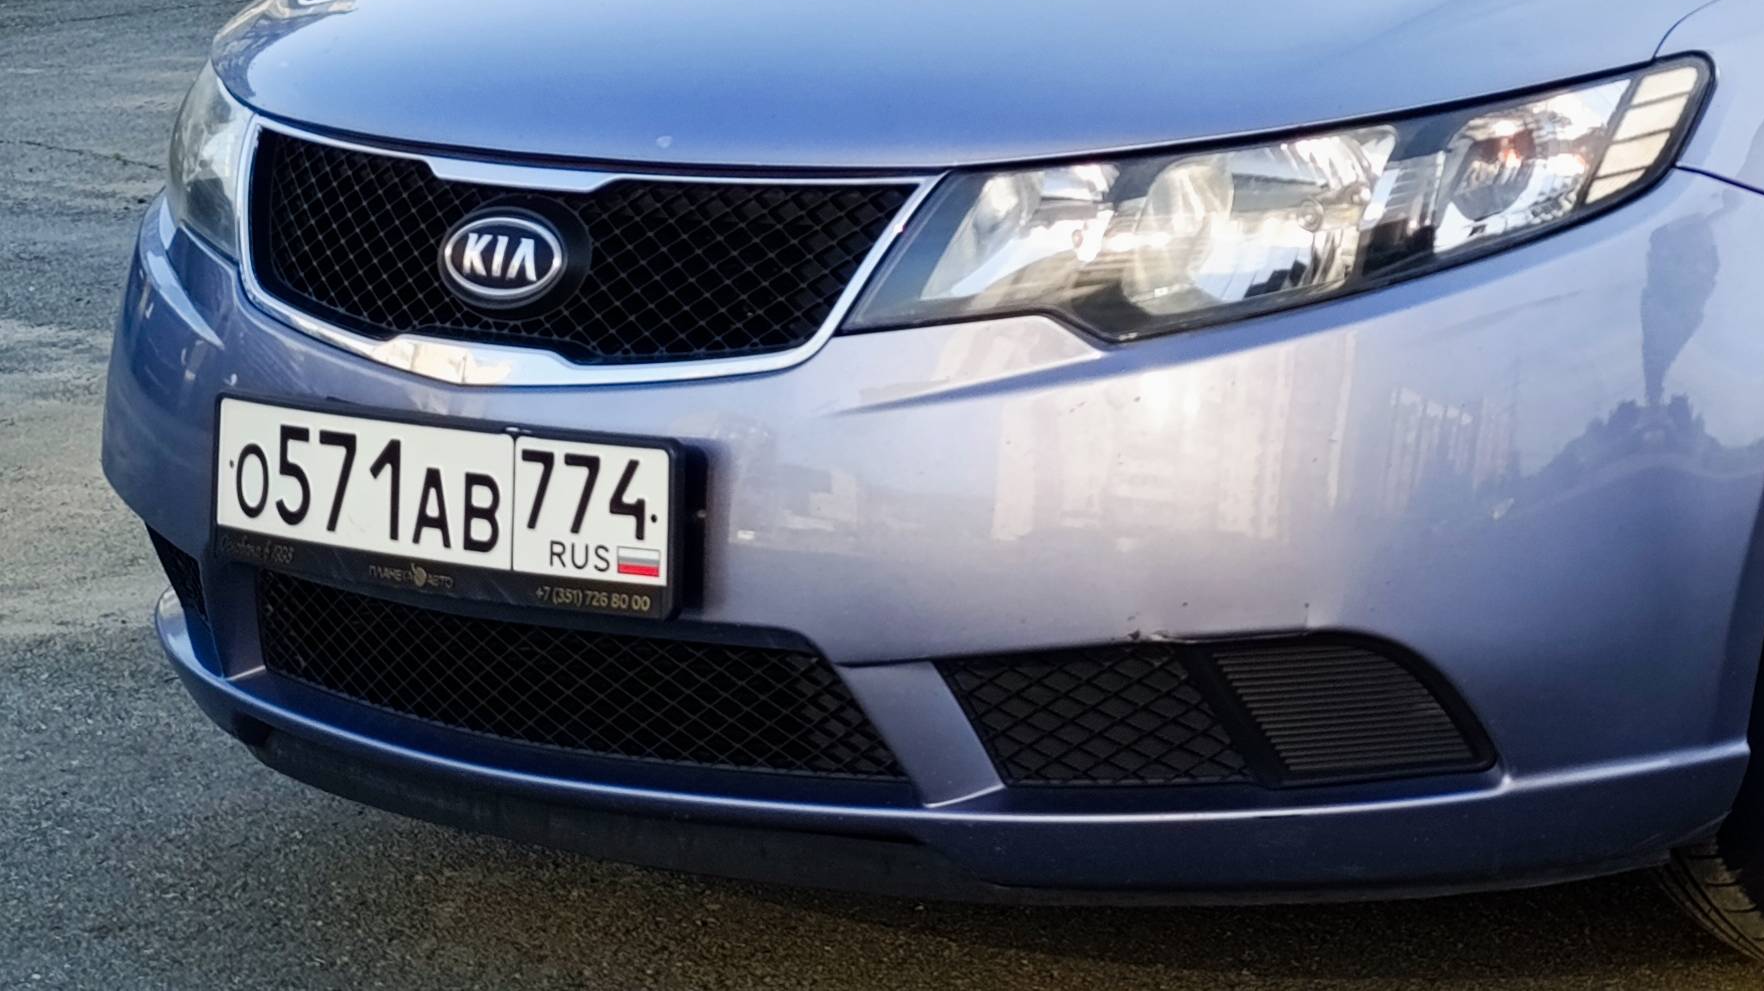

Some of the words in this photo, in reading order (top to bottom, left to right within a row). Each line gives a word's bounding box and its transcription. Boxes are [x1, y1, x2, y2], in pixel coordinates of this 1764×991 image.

[462, 232, 537, 282] KIA
[521, 449, 647, 541] 774
[549, 540, 611, 573] RUS
[536, 586, 551, 601] +7
[552, 587, 582, 606] (351)
[585, 590, 608, 606] 726
[611, 593, 629, 608] 80
[631, 595, 651, 611] 00
